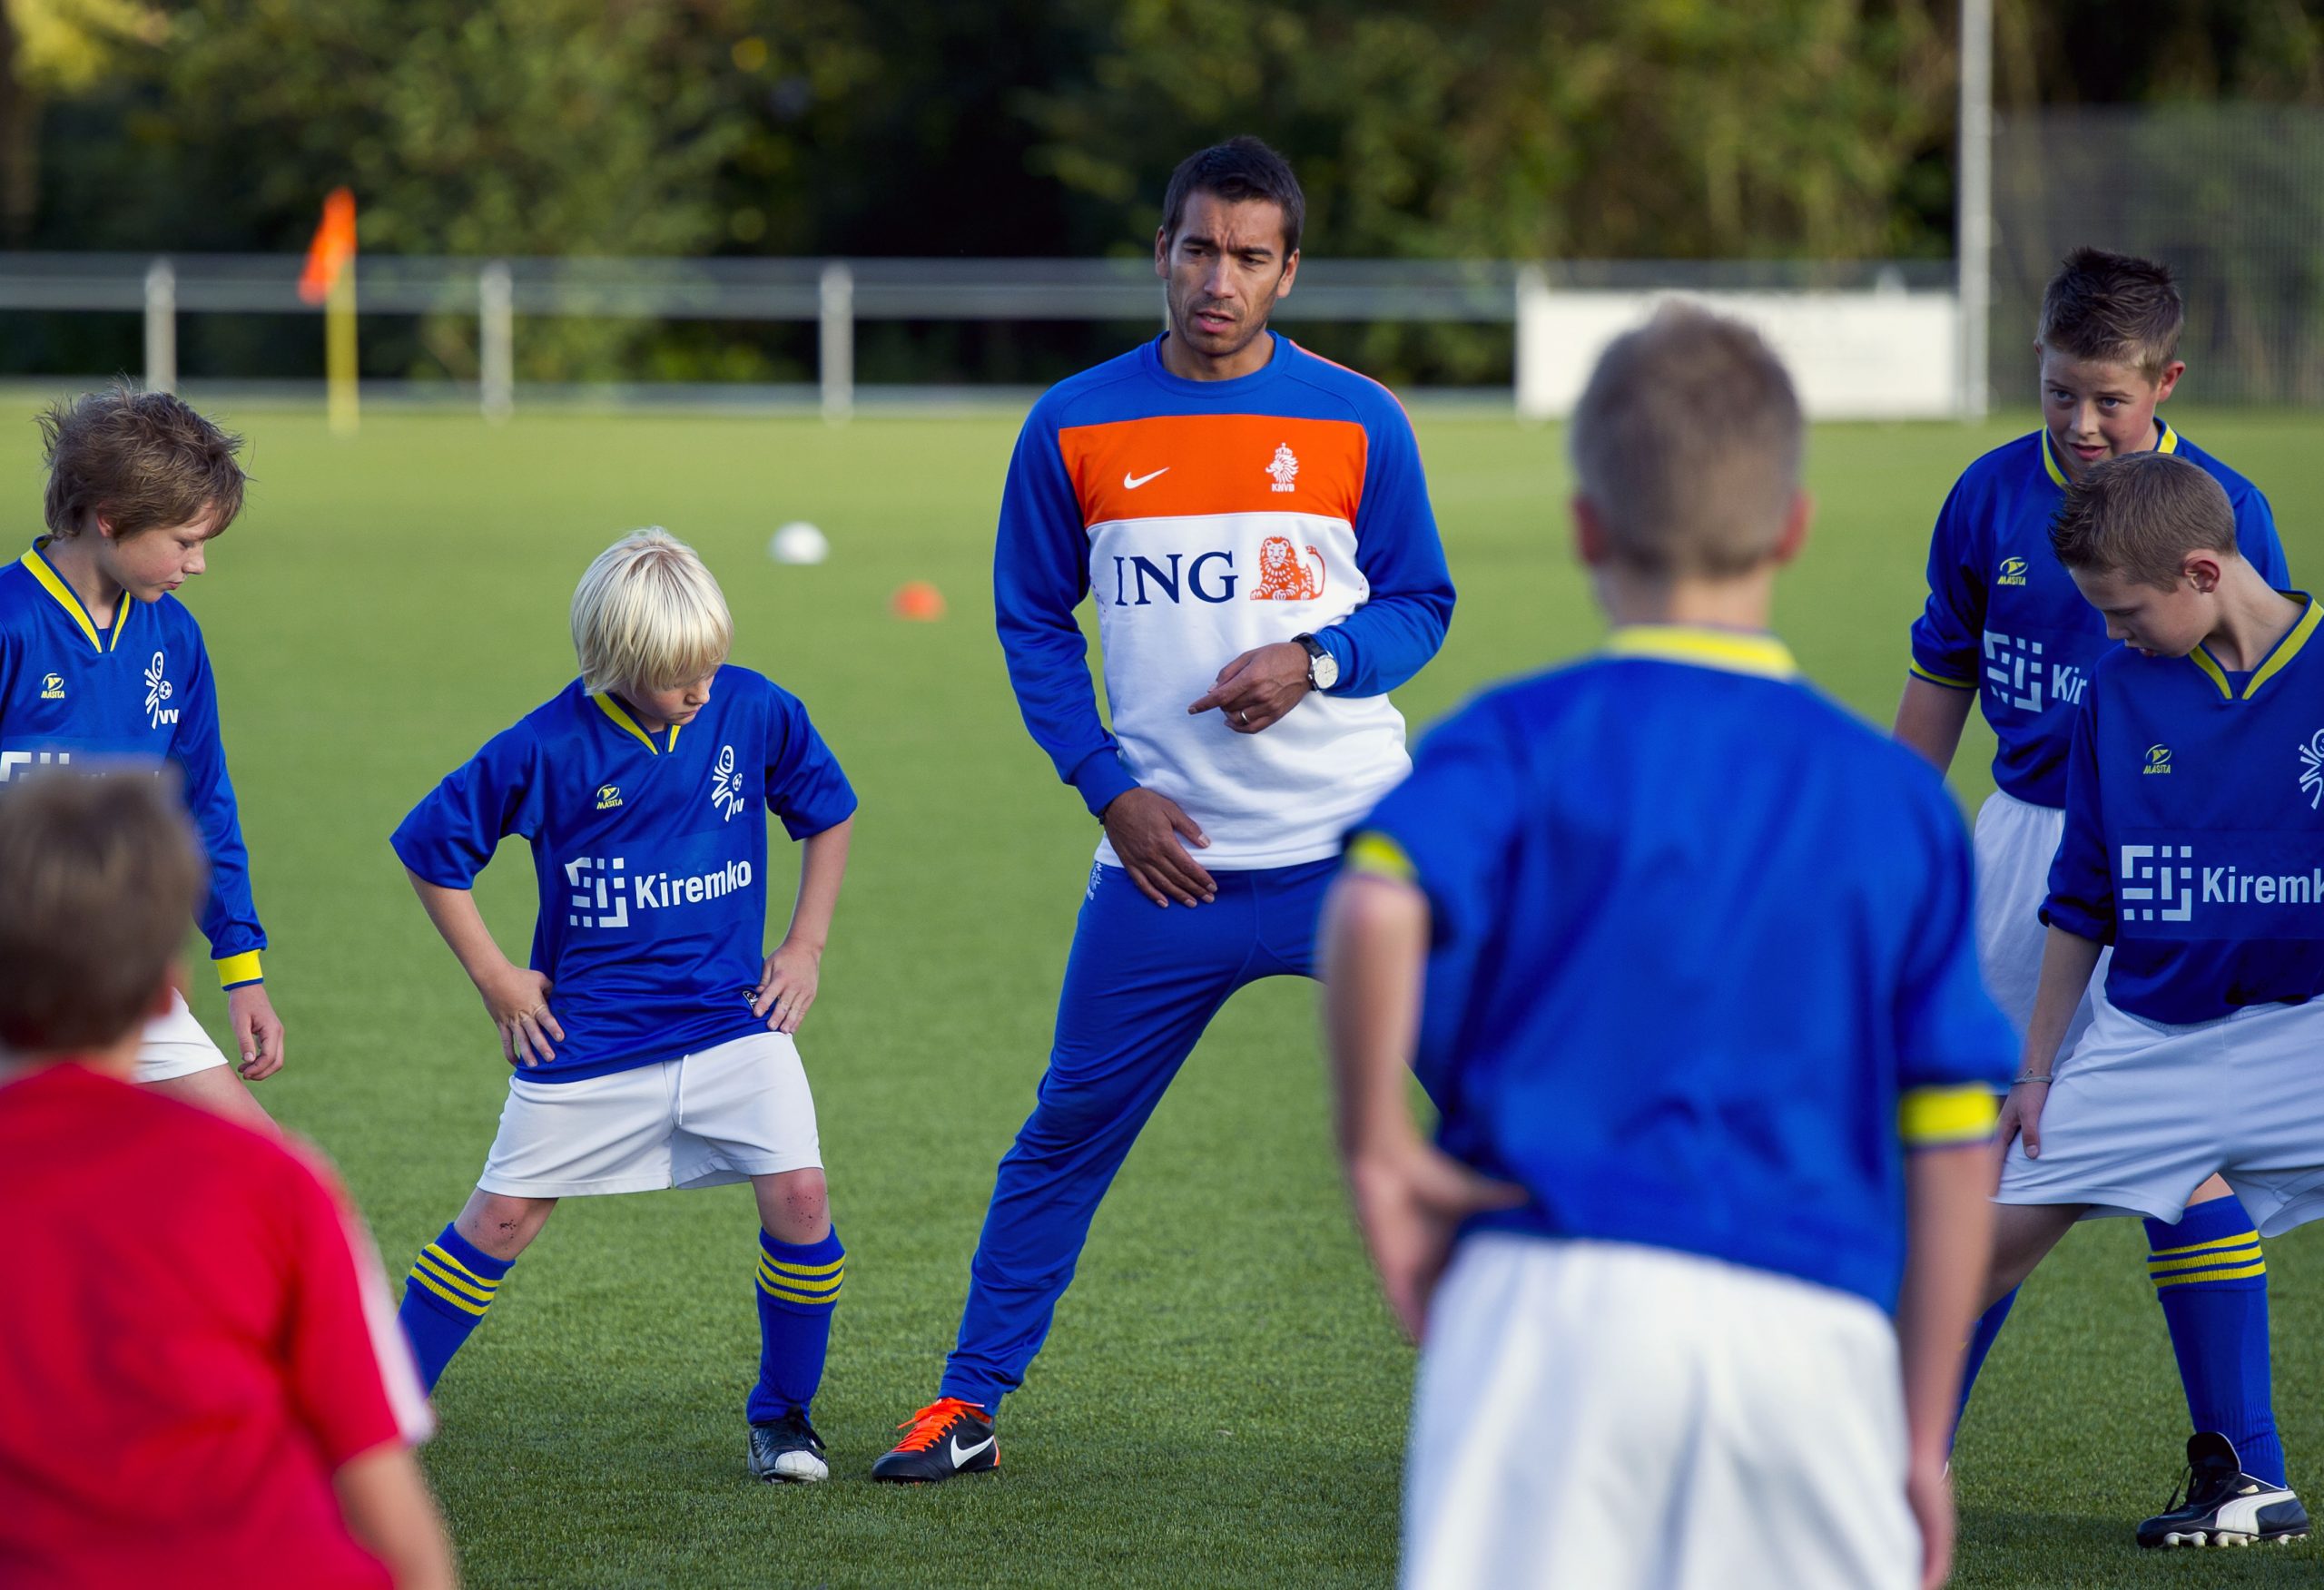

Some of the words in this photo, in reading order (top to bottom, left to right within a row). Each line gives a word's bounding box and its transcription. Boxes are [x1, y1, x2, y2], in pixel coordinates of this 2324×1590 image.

[1271, 483, 1295, 492] KNVB
[1113, 550, 1238, 606] ING
[1997, 575, 2026, 585] MASITA
[41, 691, 64, 699] MASITA
[2143, 764, 2171, 774] MASITA
[596, 798, 623, 810] MASITA
[635, 860, 752, 908] Kiremko
